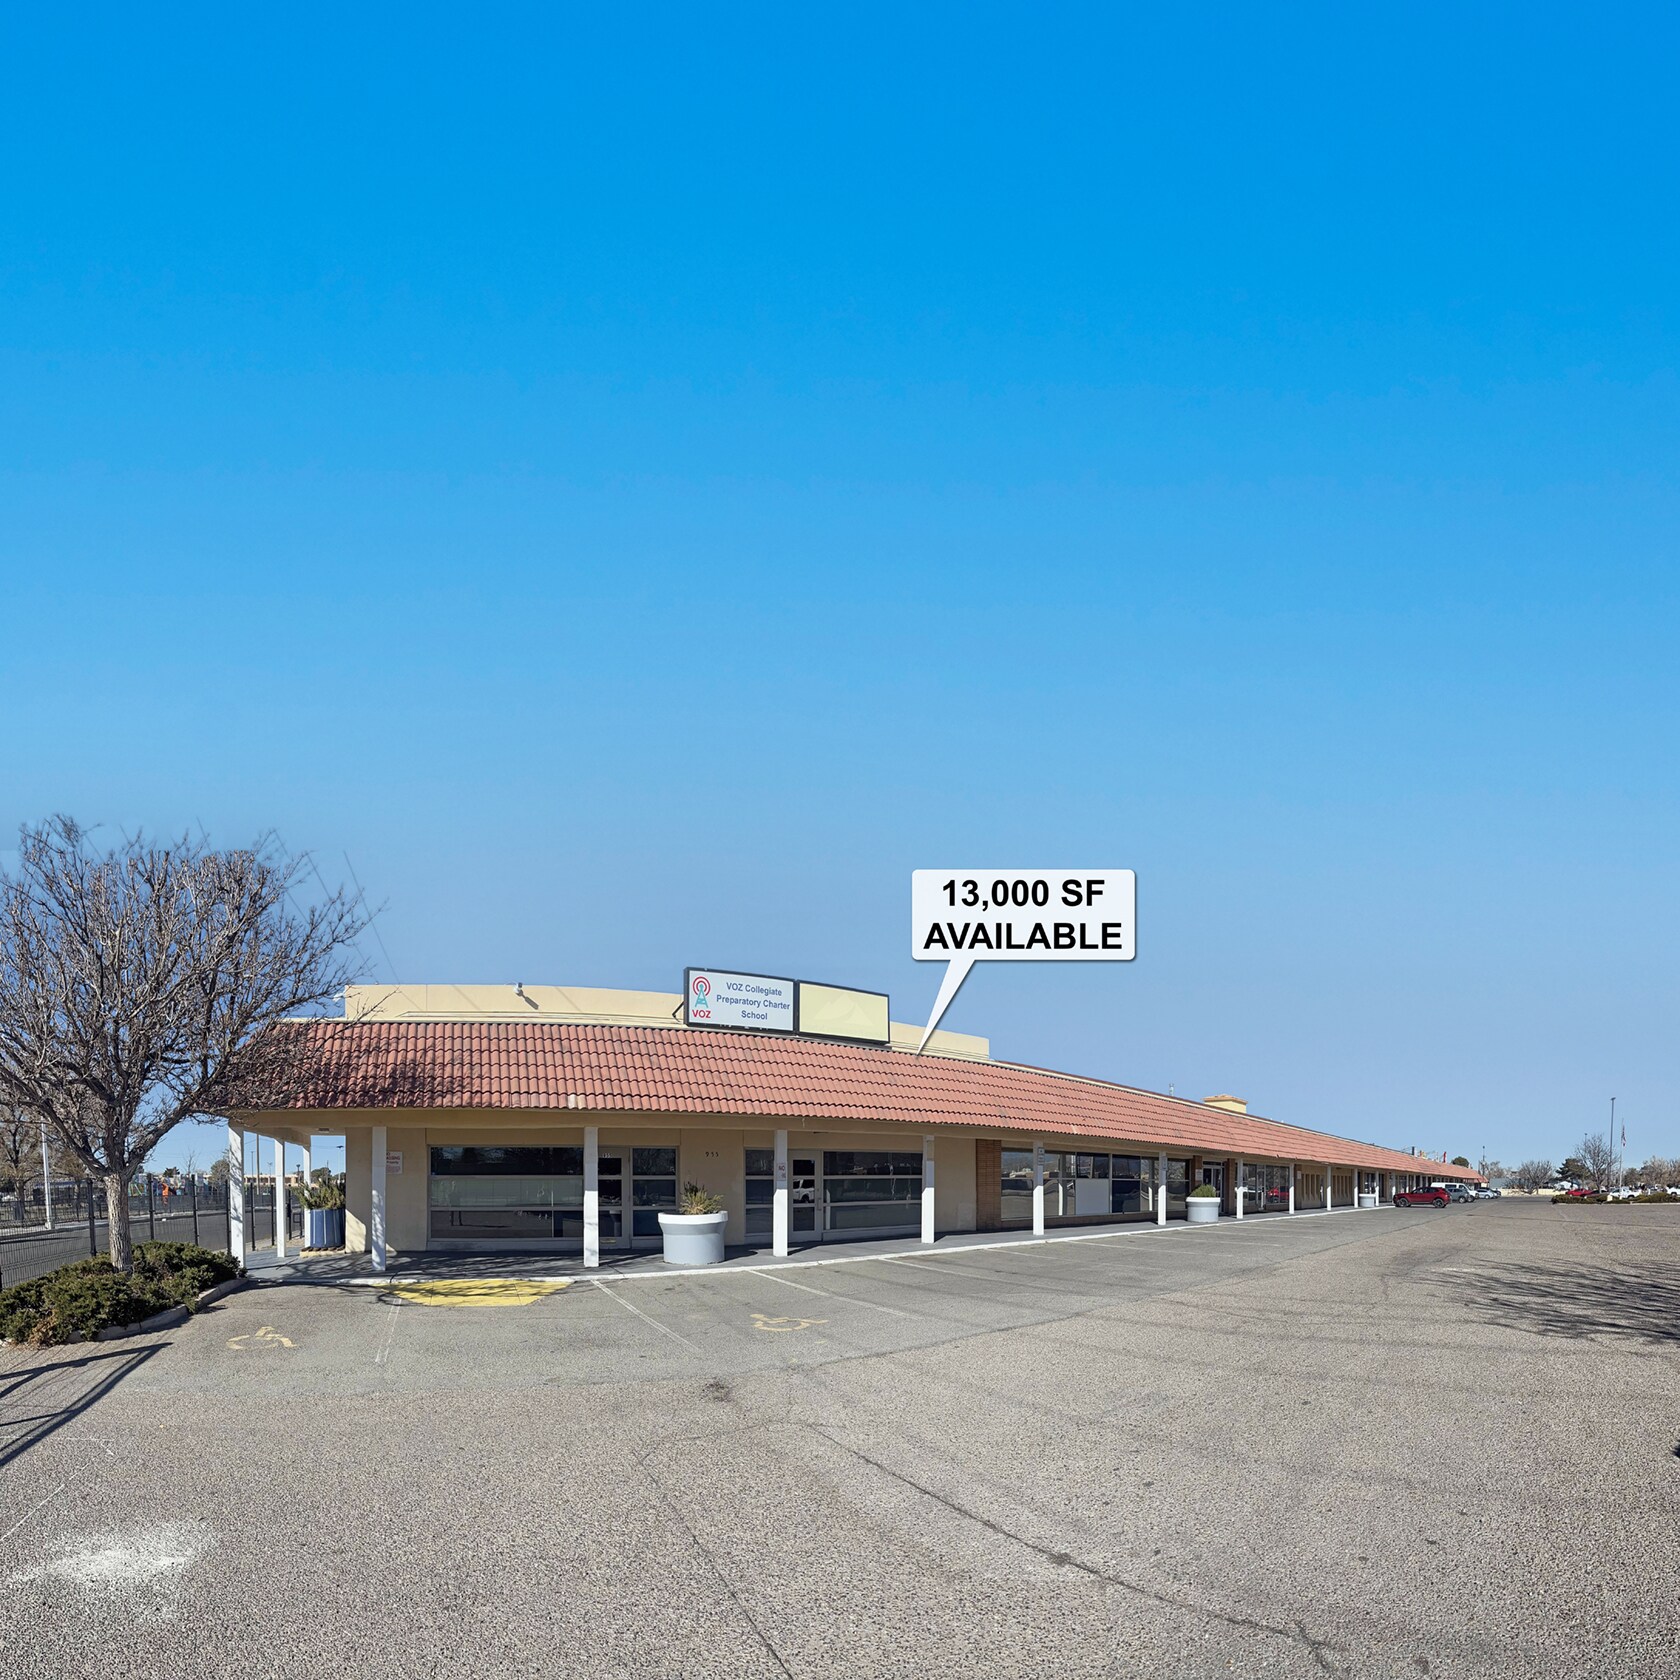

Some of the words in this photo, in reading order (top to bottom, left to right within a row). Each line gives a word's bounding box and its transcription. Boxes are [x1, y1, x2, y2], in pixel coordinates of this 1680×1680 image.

[726, 982, 743, 992] VOZ
[745, 984, 782, 996] Collegiate
[716, 994, 761, 1008] Preparatory
[763, 999, 790, 1010] Charter
[692, 1009, 711, 1019] VOZ
[741, 1010, 768, 1020] School
